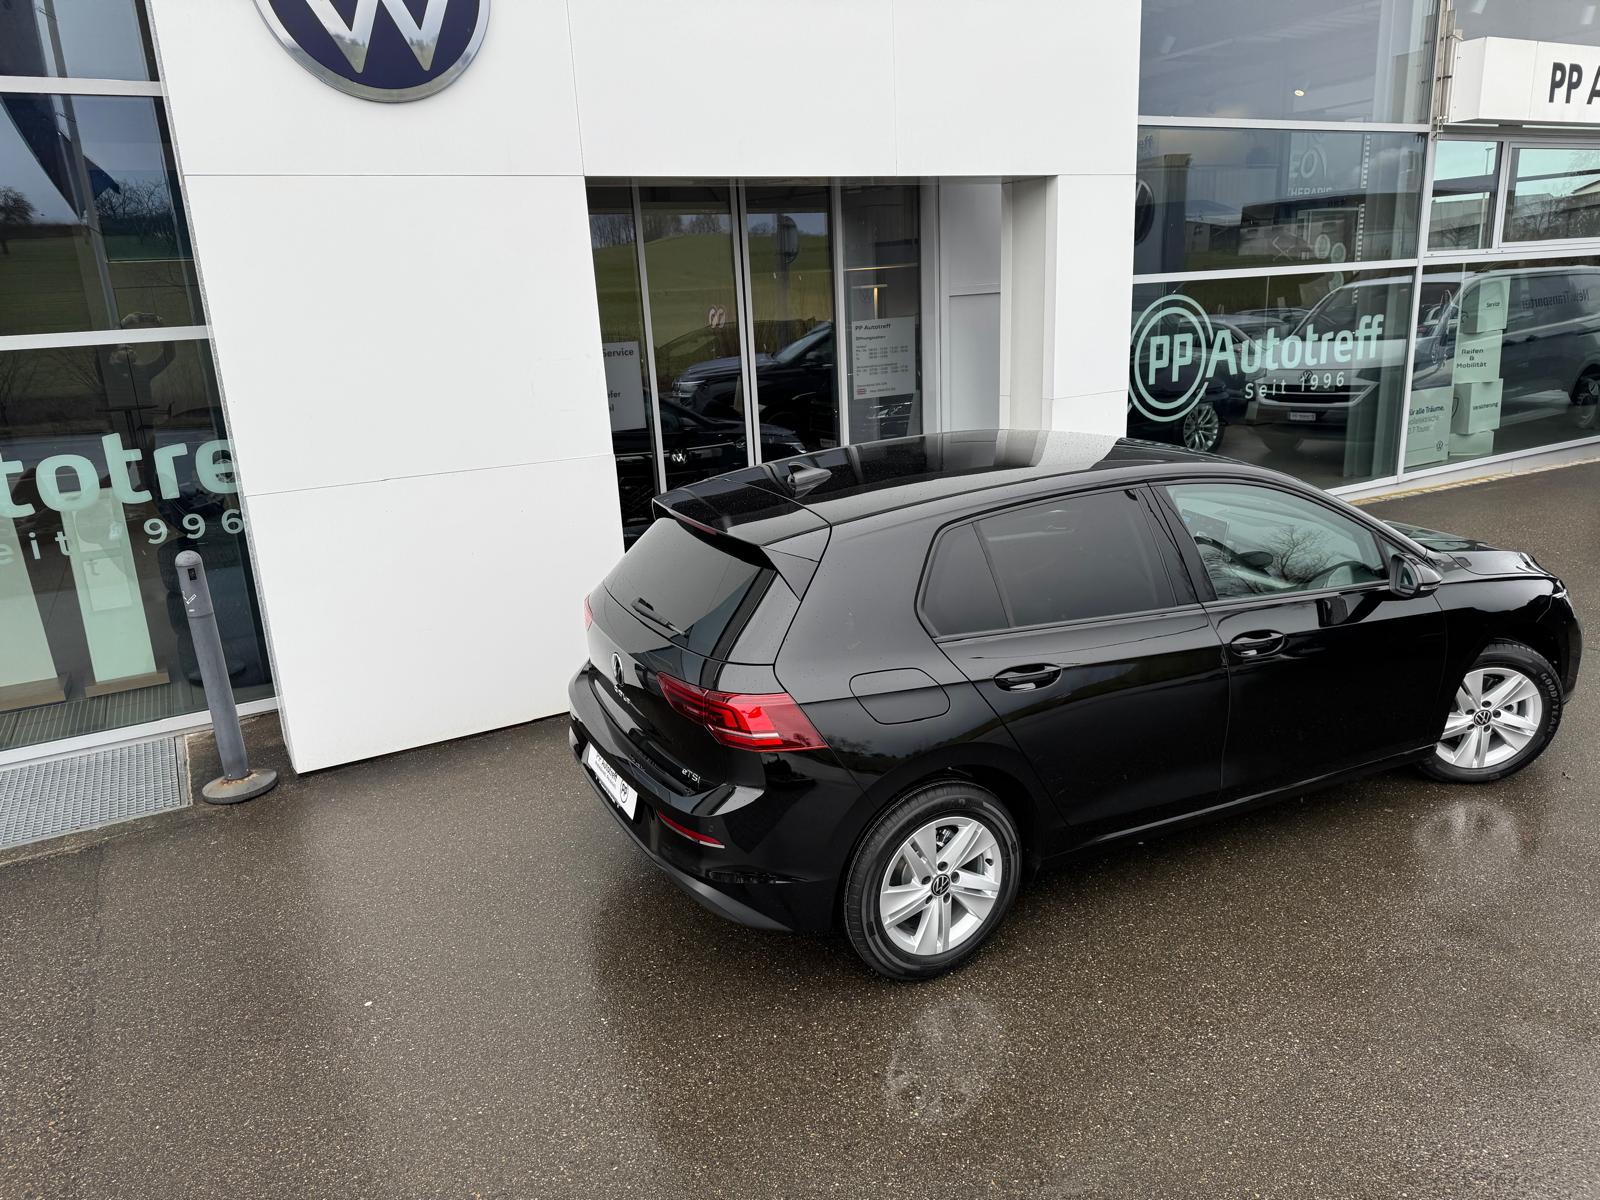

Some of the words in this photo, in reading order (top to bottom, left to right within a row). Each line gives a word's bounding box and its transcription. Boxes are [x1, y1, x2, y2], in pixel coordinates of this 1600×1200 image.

[1549, 62, 1583, 104] PP
[1149, 333, 1193, 385] PP
[1206, 314, 1384, 378] Autotreff
[1456, 361, 1487, 369] Mobilität
[1245, 379, 1287, 400] Seit
[1300, 371, 1345, 392] 1996
[681, 768, 701, 783] eTSI
